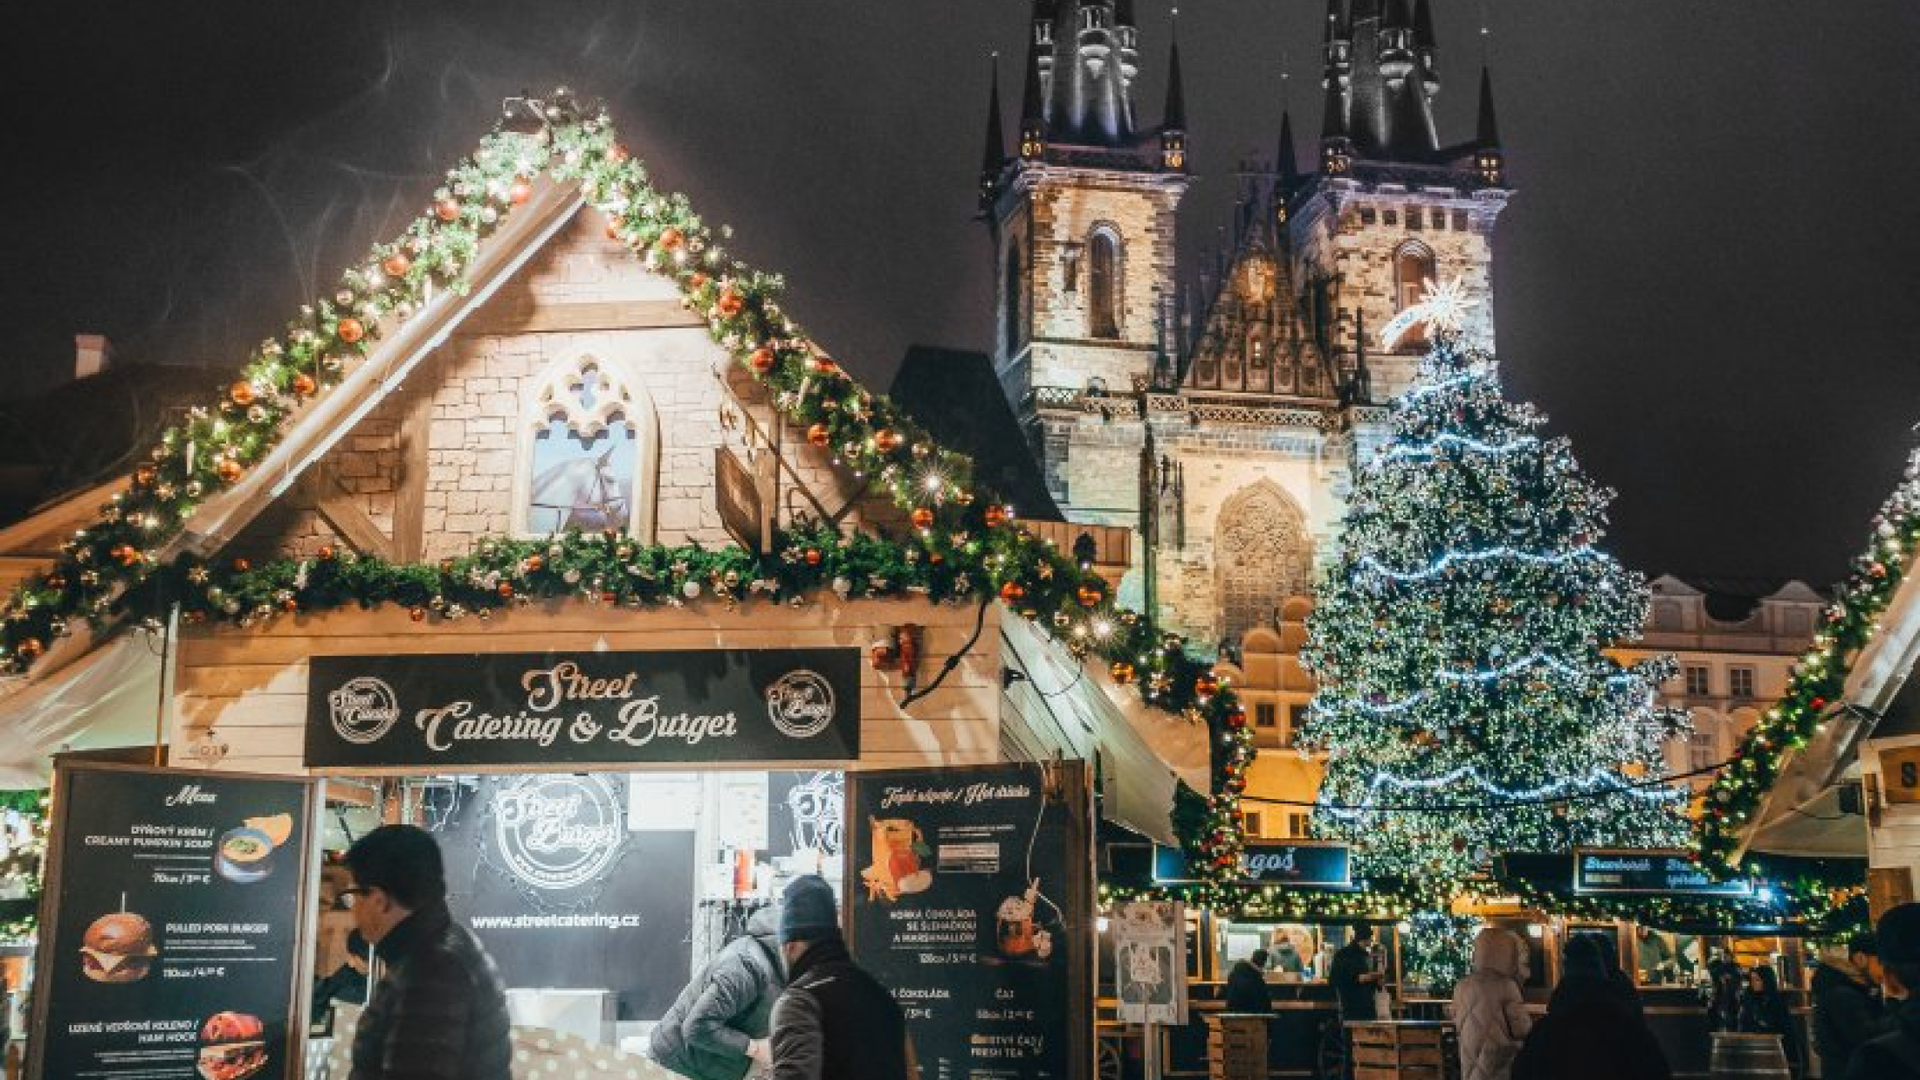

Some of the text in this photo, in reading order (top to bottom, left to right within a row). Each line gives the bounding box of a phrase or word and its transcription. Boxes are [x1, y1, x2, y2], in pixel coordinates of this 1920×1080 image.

[521, 661, 637, 712] Street
[415, 695, 737, 751] Catering & Burger
[85, 836, 213, 848] CREAMY PUMPKIN SOUP
[165, 923, 269, 934] PULLED PORK BURGER
[471, 911, 640, 929] www.streetcatering.cz
